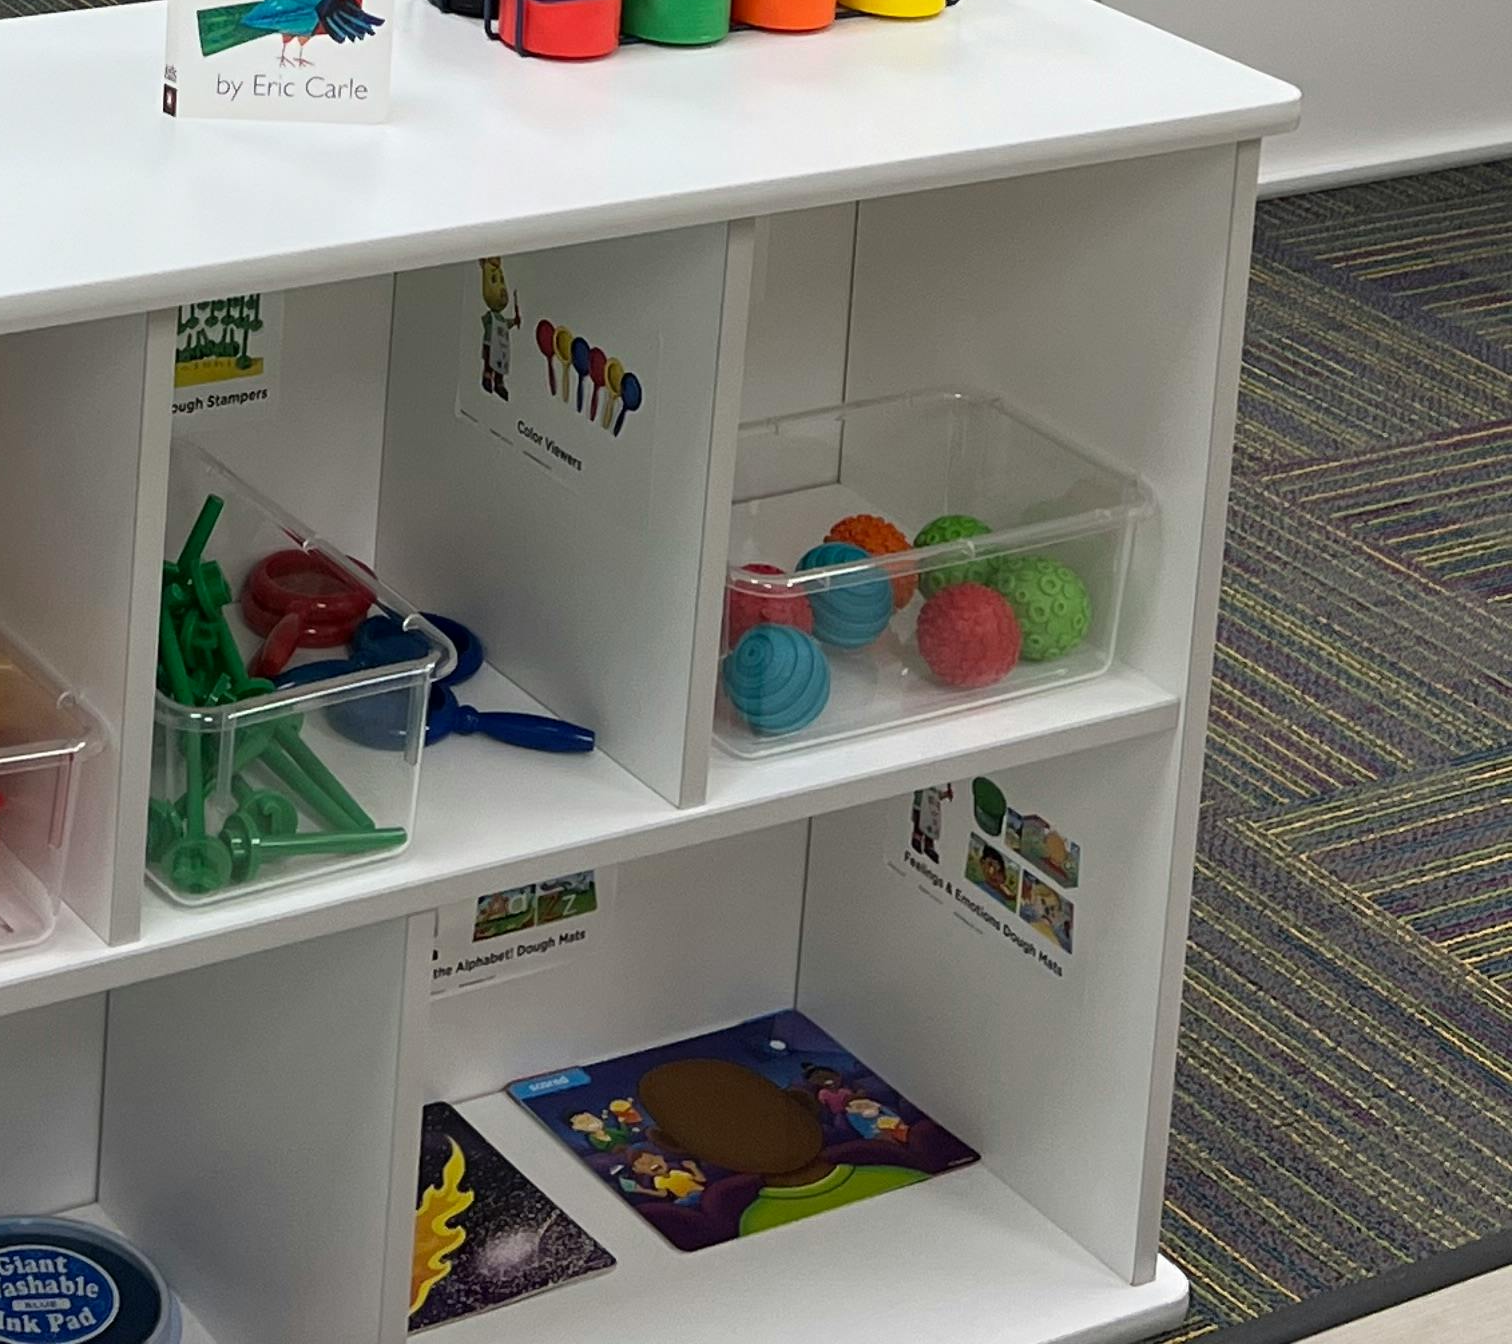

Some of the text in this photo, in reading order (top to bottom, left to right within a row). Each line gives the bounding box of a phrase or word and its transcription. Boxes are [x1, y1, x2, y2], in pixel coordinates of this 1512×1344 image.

[216, 73, 368, 101] by Eric Carle
[207, 389, 268, 408] Stampers
[517, 420, 582, 471] Color Viewers
[904, 851, 1063, 977] Feelings & Emotions Dough Mats
[433, 929, 586, 980] the Alphabet! Dough Mats
[529, 1075, 569, 1091] scared
[46, 1306, 97, 1333] Pad
